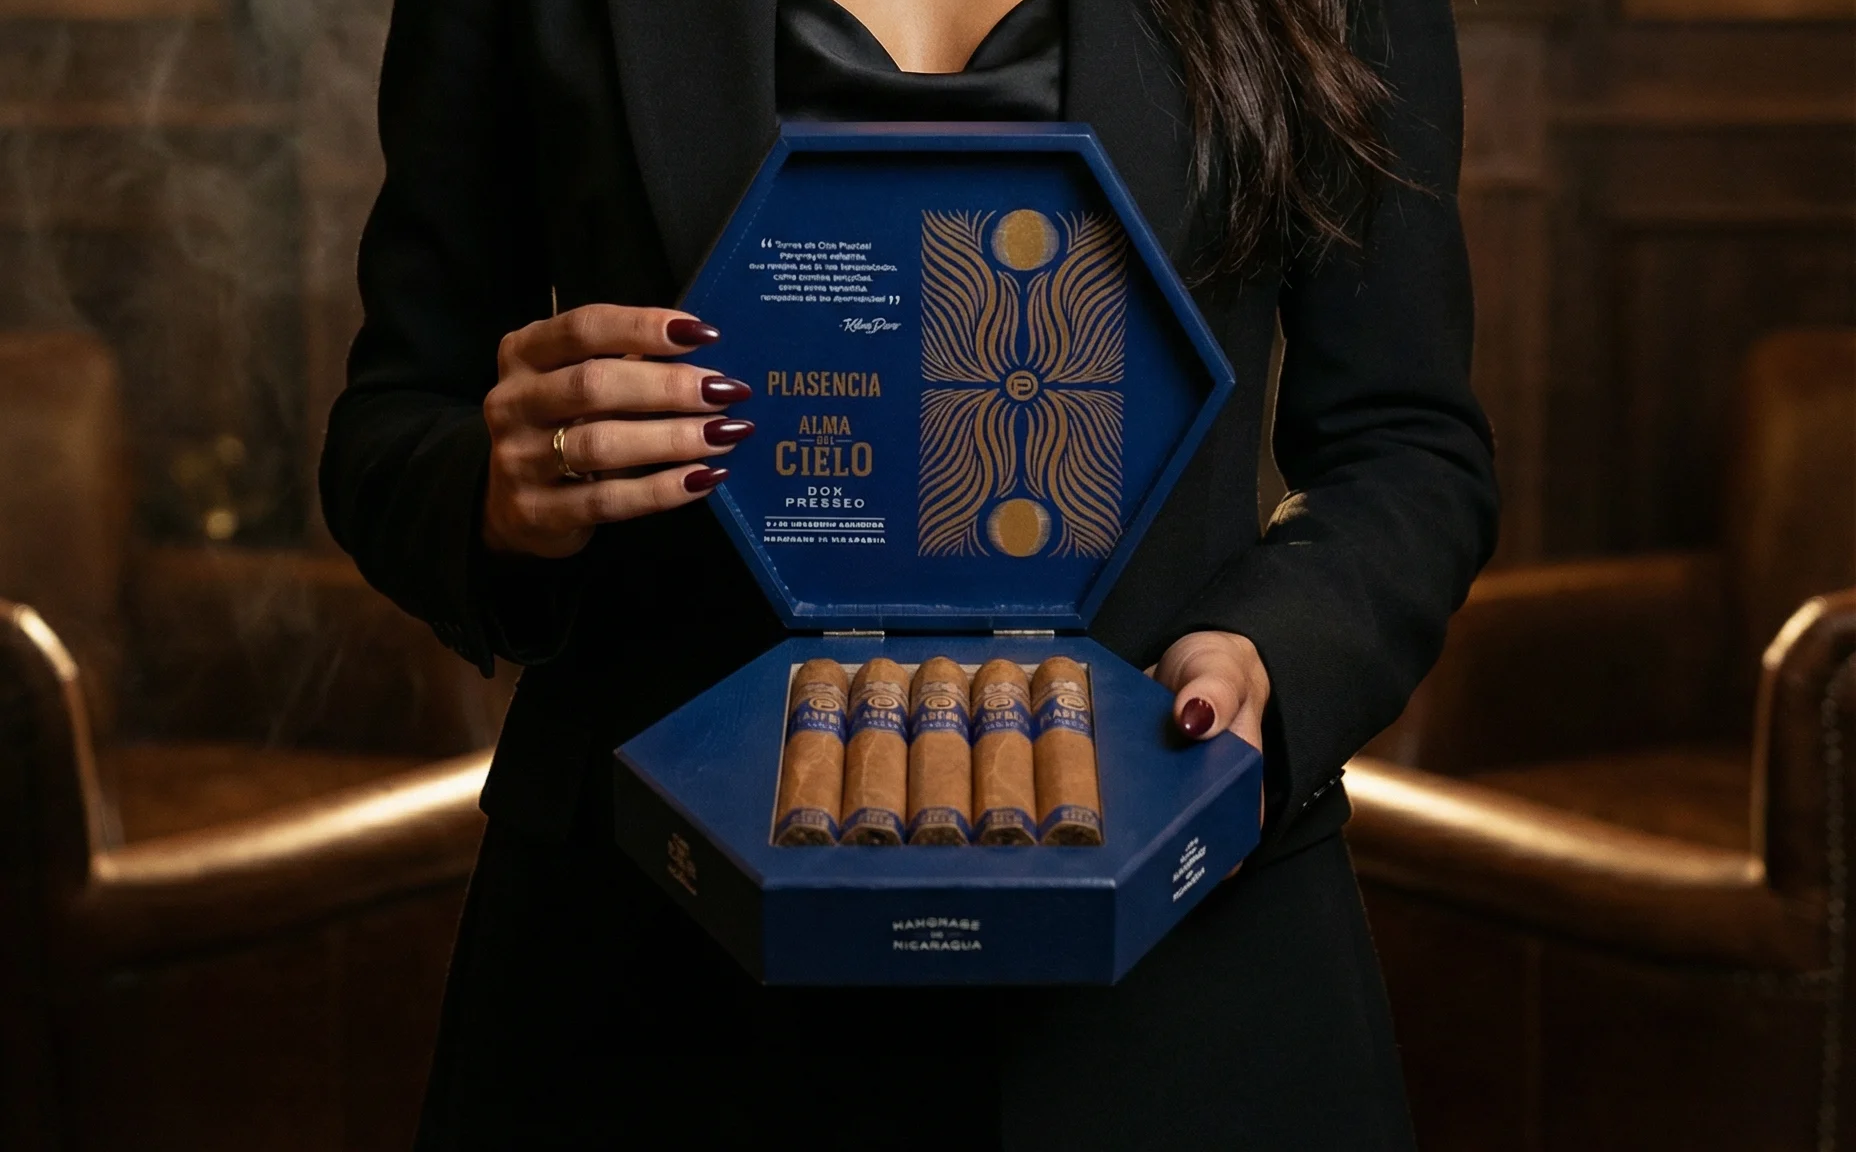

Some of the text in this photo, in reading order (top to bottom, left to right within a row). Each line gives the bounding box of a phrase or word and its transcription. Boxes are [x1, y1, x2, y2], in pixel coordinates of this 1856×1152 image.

[768, 371, 881, 398] PLASENCIA
[799, 415, 852, 436] ALMA
[775, 440, 873, 478] CIELO
[785, 497, 865, 509] PRESSEO
